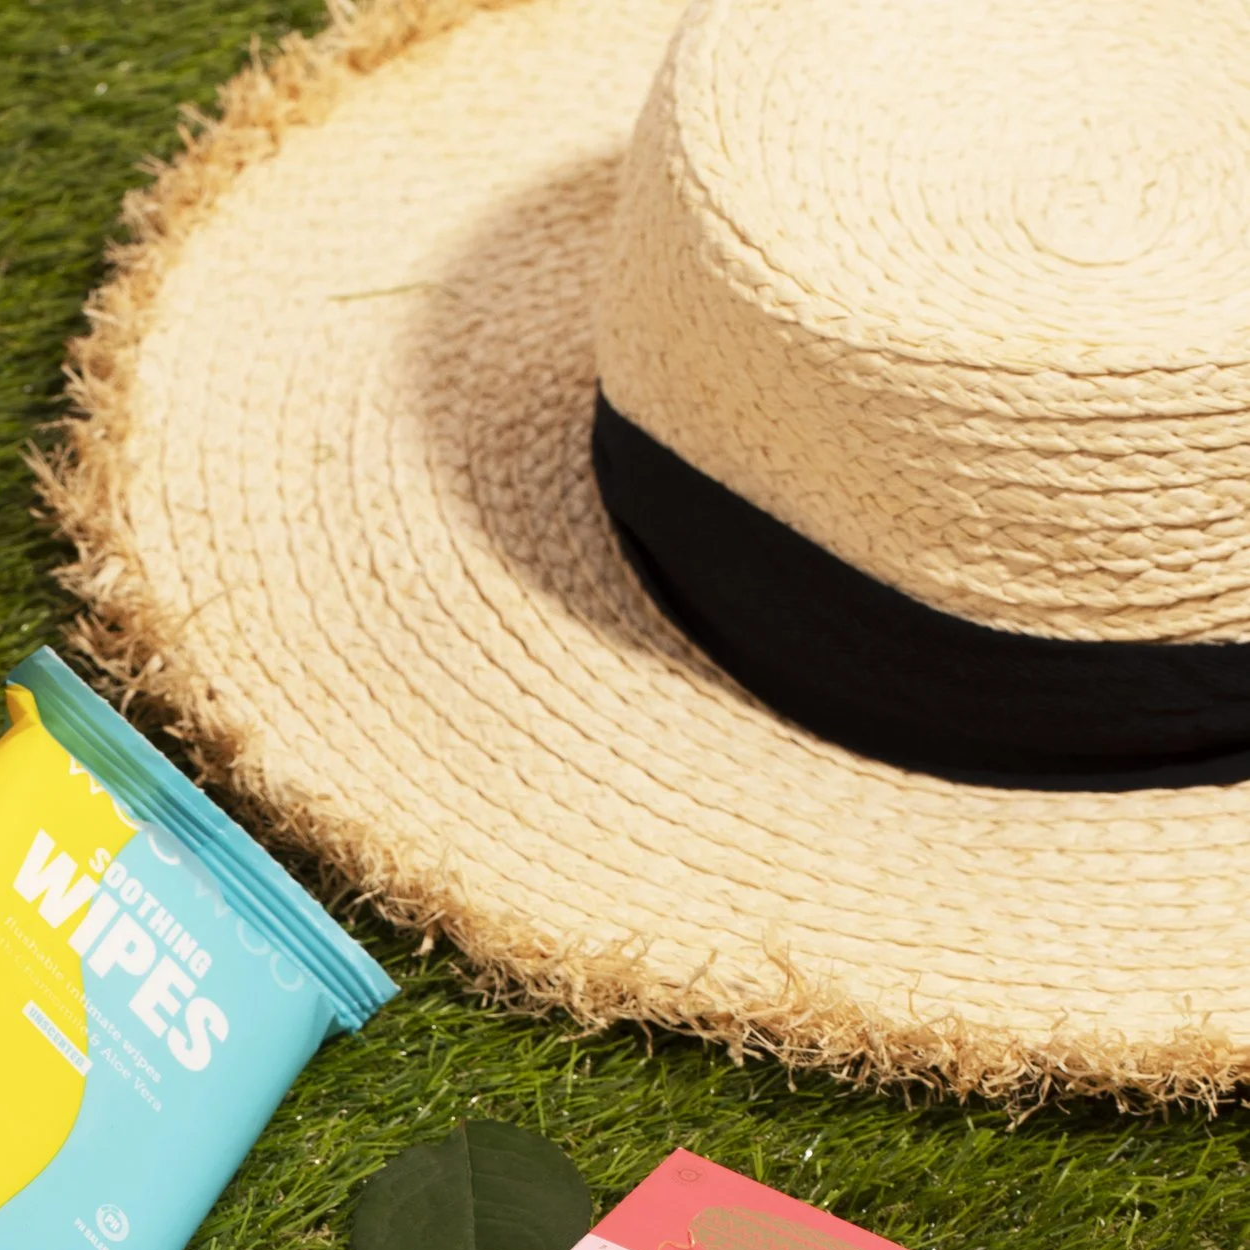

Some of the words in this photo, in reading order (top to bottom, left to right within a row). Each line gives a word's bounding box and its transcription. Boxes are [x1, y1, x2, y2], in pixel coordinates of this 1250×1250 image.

[13, 828, 229, 1072] WIPES
[89, 847, 212, 979] SOOTHING
[4, 916, 64, 981] flushable
[66, 982, 122, 1042] intimate
[122, 1040, 162, 1083] wipes
[28, 1006, 86, 1068] UNSCENTED
[90, 1033, 100, 1047] &
[100, 1047, 132, 1080] Aloe
[134, 1077, 162, 1112] Vera
[74, 1218, 86, 1233] PH
[104, 1212, 120, 1232] PH
